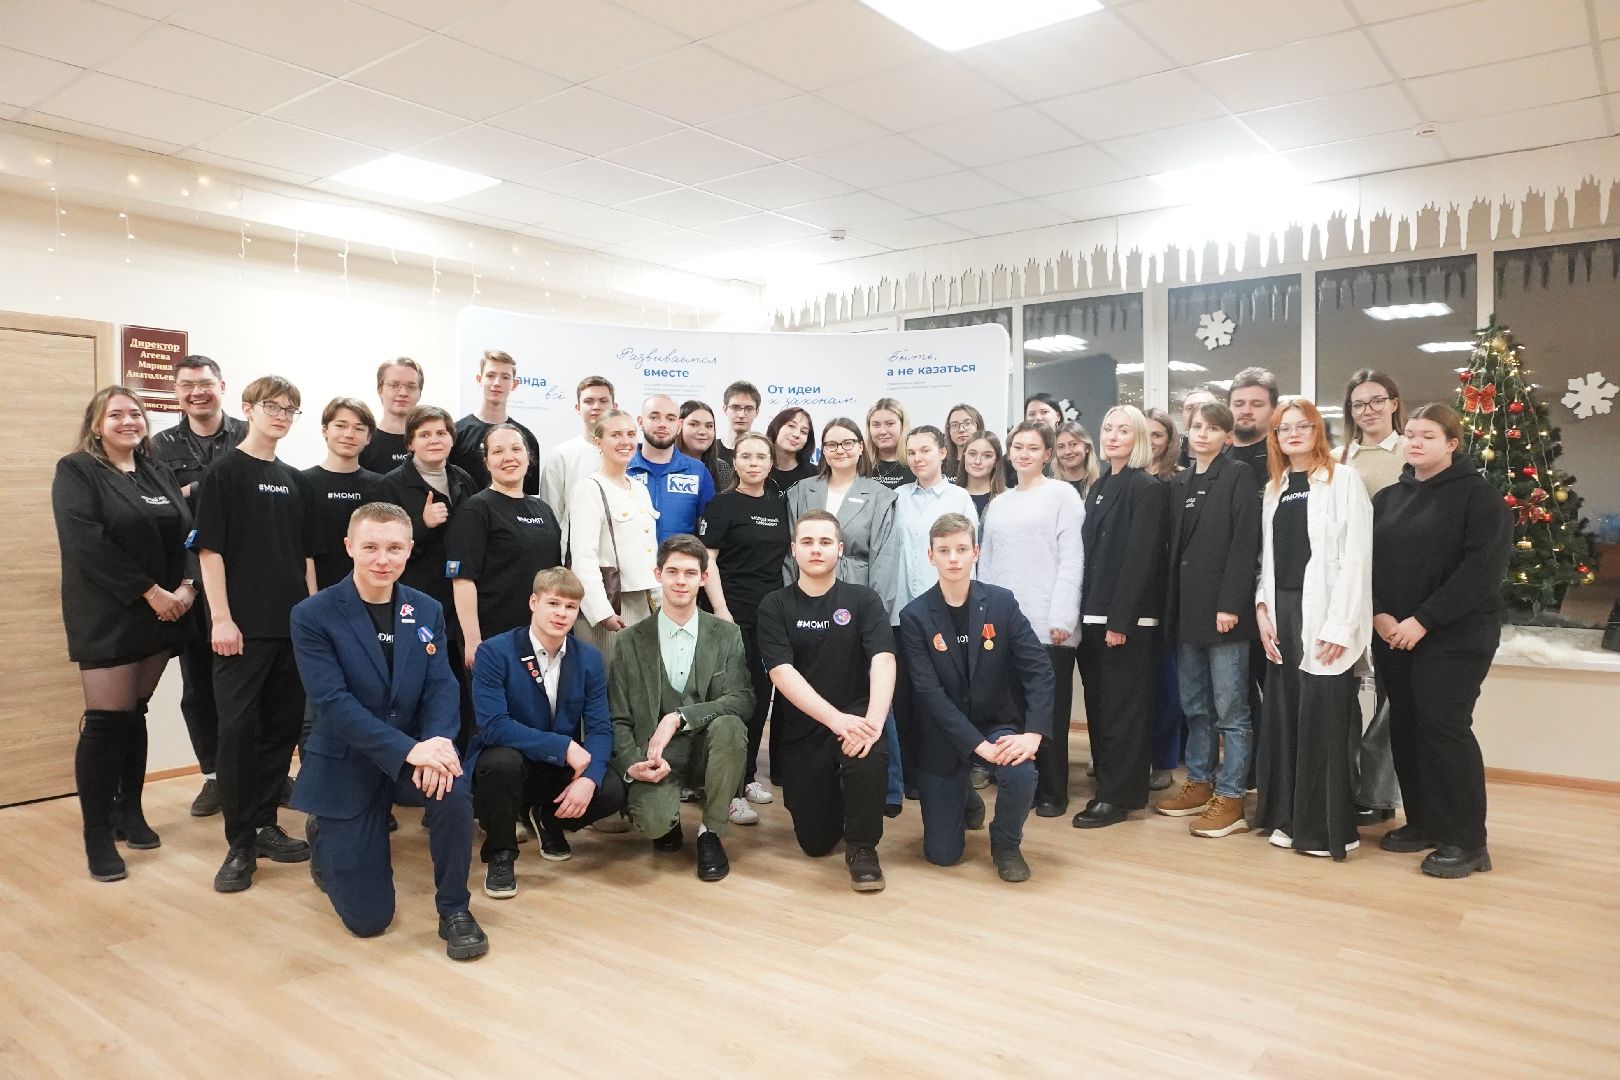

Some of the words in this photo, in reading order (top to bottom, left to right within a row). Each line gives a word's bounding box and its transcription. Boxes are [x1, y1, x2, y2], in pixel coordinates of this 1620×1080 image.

[129, 338, 181, 351] Директор
[140, 351, 171, 360] Агеева
[138, 360, 173, 371] Марина
[886, 368, 894, 377] а
[898, 367, 914, 376] не
[918, 363, 976, 375] казаться
[126, 369, 175, 381] Анатольев
[643, 368, 690, 378] вместе
[516, 376, 547, 388] анда
[767, 384, 784, 394] От
[788, 386, 821, 395] идеи
[258, 483, 289, 494] #МОМП
[327, 492, 361, 500] #МОМП
[796, 620, 830, 628] #МОМП
